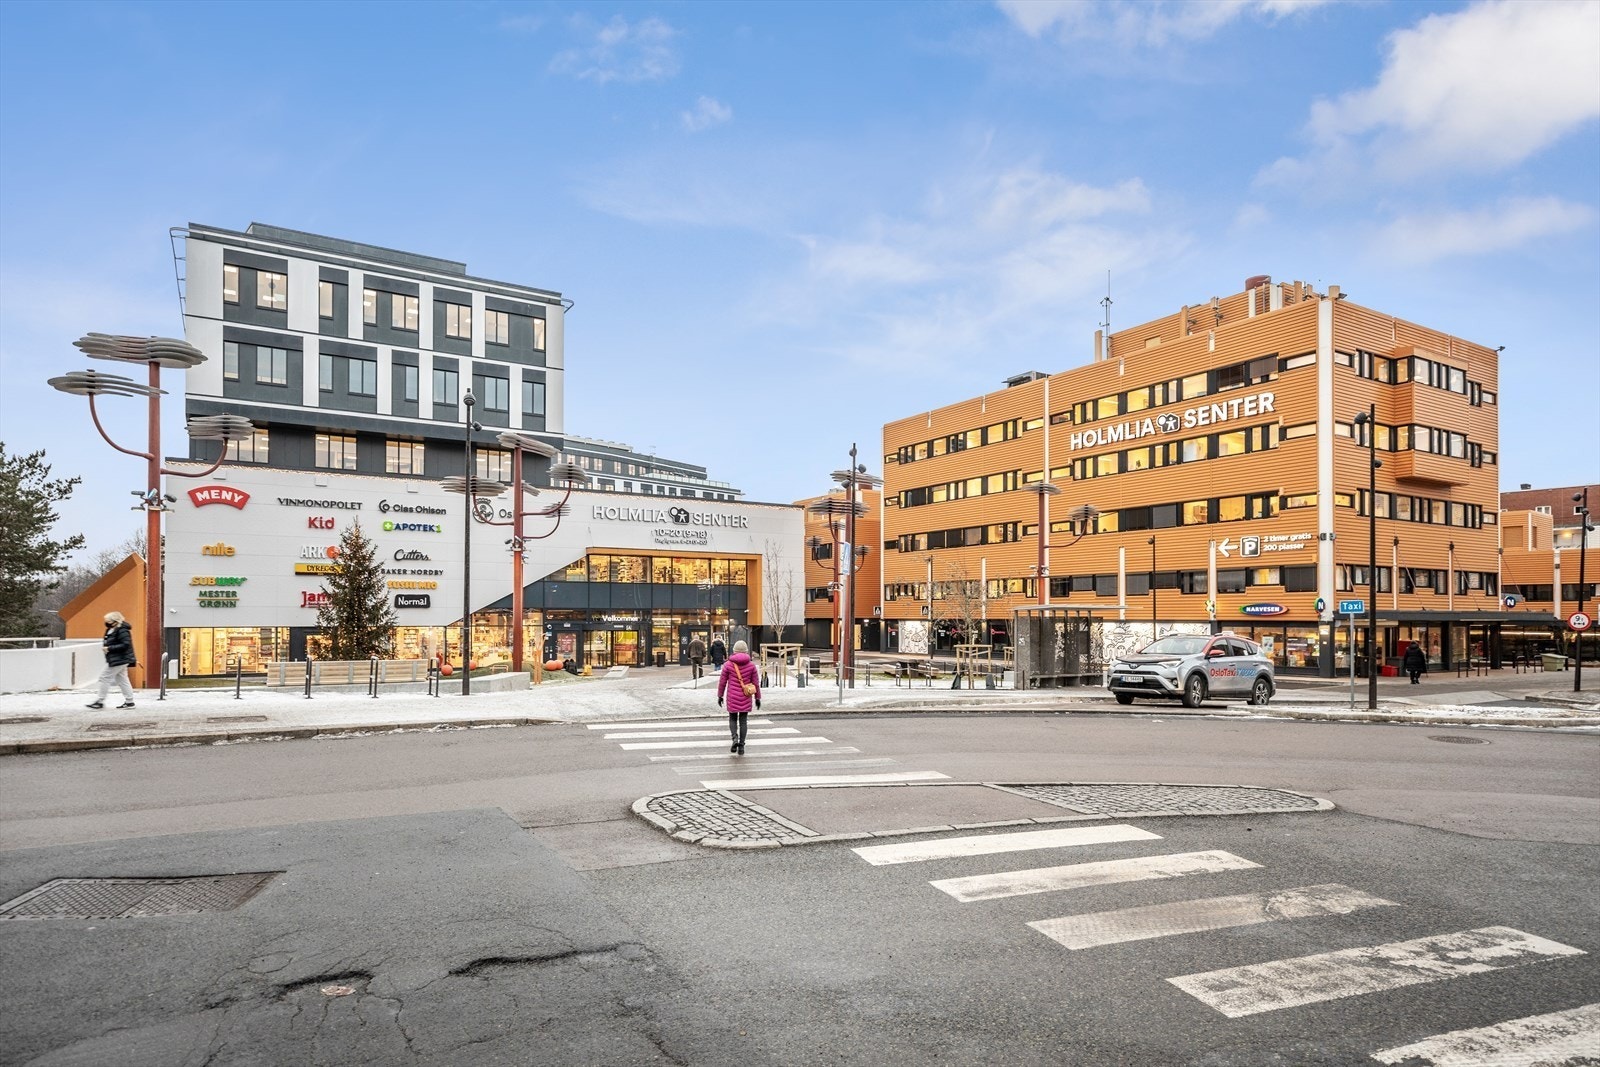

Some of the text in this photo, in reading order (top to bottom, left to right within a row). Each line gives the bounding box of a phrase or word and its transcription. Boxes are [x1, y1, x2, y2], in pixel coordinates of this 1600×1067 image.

[1070, 391, 1276, 450] HOLMLIA SENTER
[195, 489, 244, 503] MENY
[277, 497, 363, 510] VINMONOPOLET
[393, 504, 447, 515] Clas Ohlson
[593, 505, 749, 528] HOLMLIA SENTER
[307, 516, 335, 529] Kid
[394, 523, 435, 532] APOTEK
[1263, 535, 1269, 543] 2
[202, 543, 235, 557] nille
[1263, 542, 1305, 551] 200 plasser
[300, 546, 326, 559] ARK
[189, 576, 248, 587] SUBWAY
[387, 581, 438, 590] SUSHI MIO
[199, 590, 238, 598] MESTER
[199, 600, 237, 609] GRØNN
[398, 596, 427, 606] Normal
[1342, 602, 1362, 610] Taxi
[1210, 668, 1237, 677] OsloTaxi
